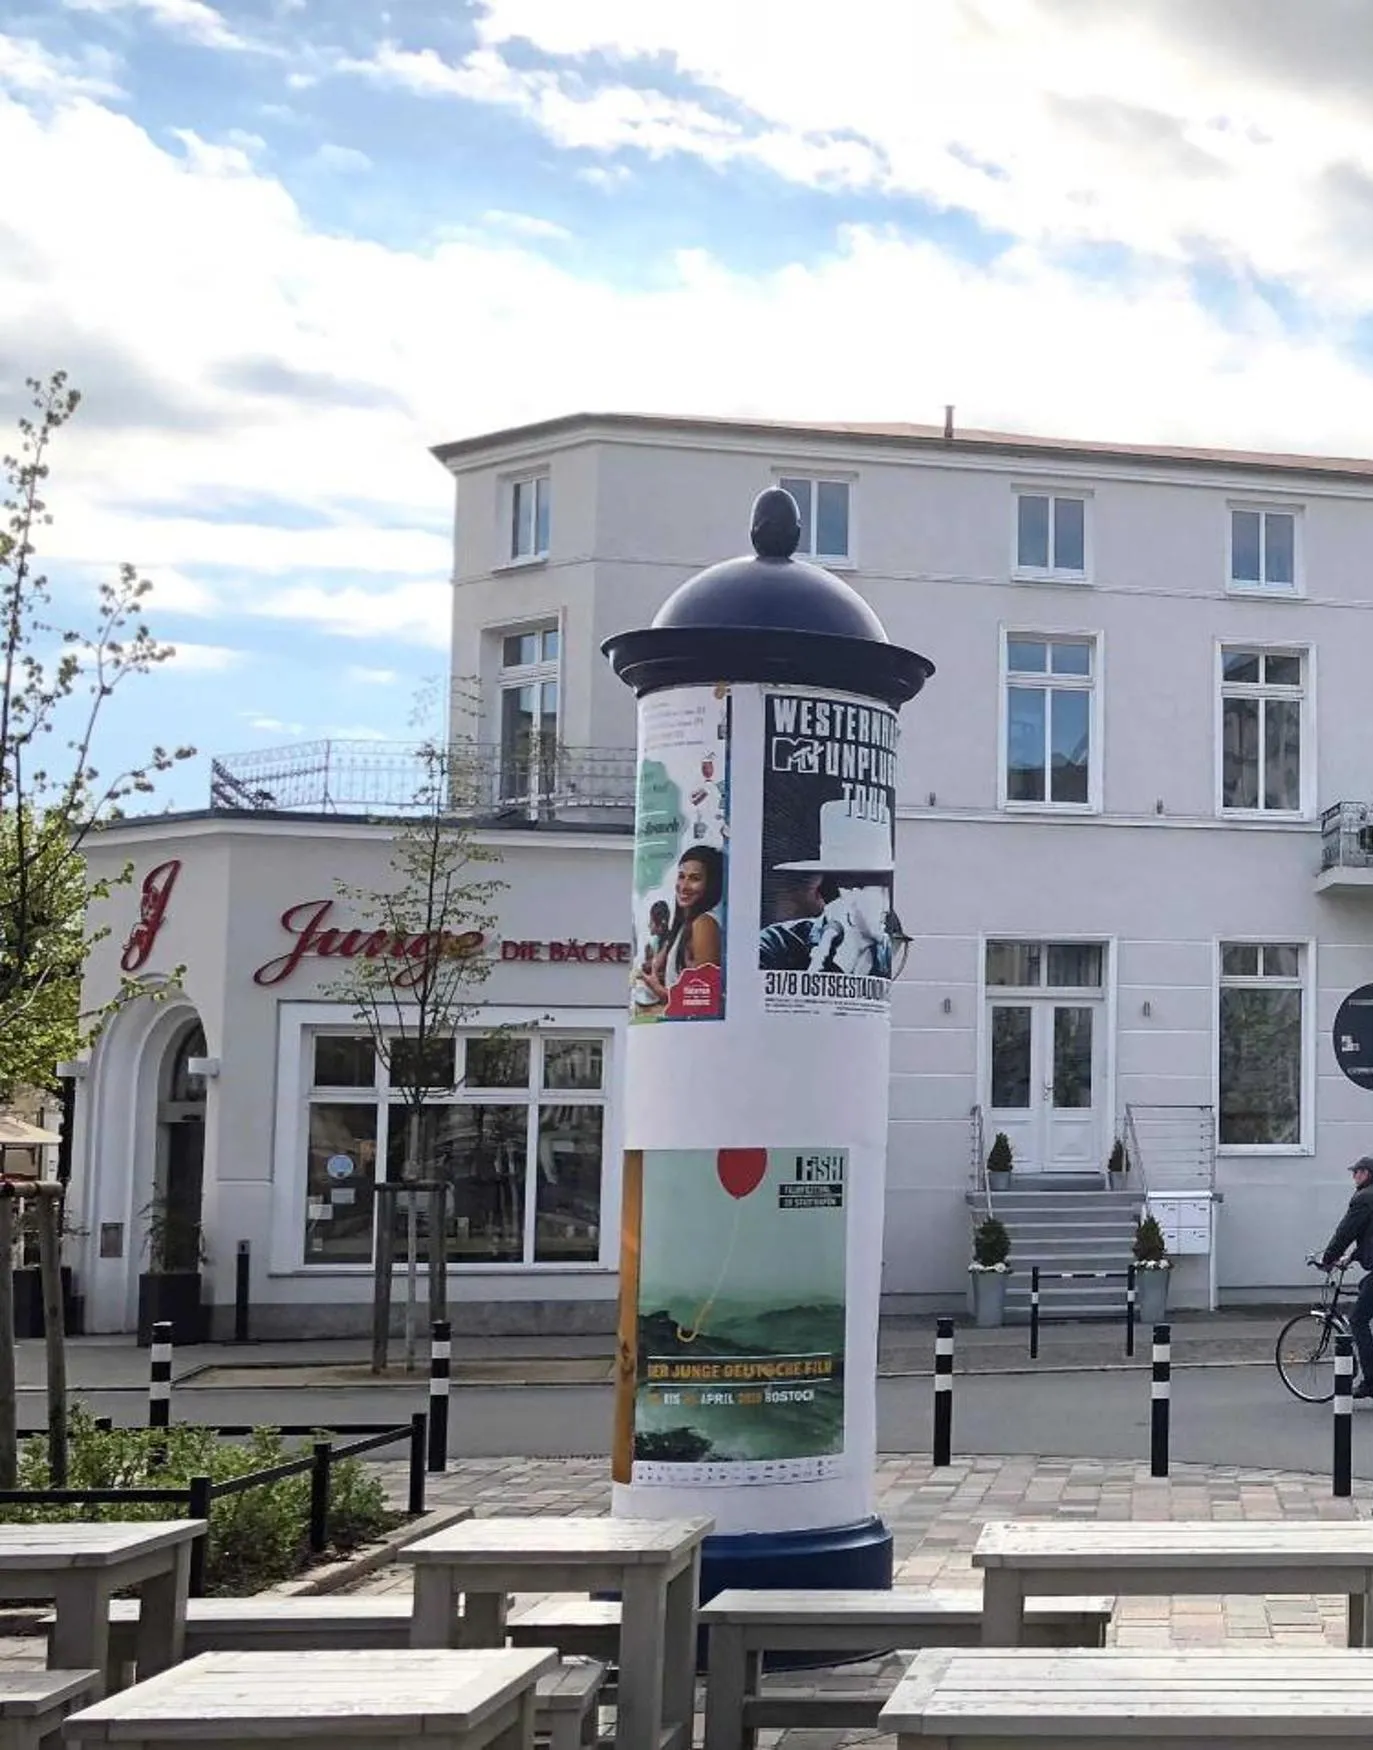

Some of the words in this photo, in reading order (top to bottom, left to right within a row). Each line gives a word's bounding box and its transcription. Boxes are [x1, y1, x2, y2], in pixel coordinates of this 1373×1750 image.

[842, 781, 890, 824] TOUR
[253, 899, 484, 987] Junge
[502, 940, 542, 961] DIE
[549, 937, 631, 964] BÄCKE
[765, 971, 797, 996] 31/8
[671, 1363, 720, 1378] JUNGE
[724, 1361, 801, 1379] DEUTSCHE
[803, 1358, 832, 1375] FILM
[701, 1392, 735, 1405] APRIL
